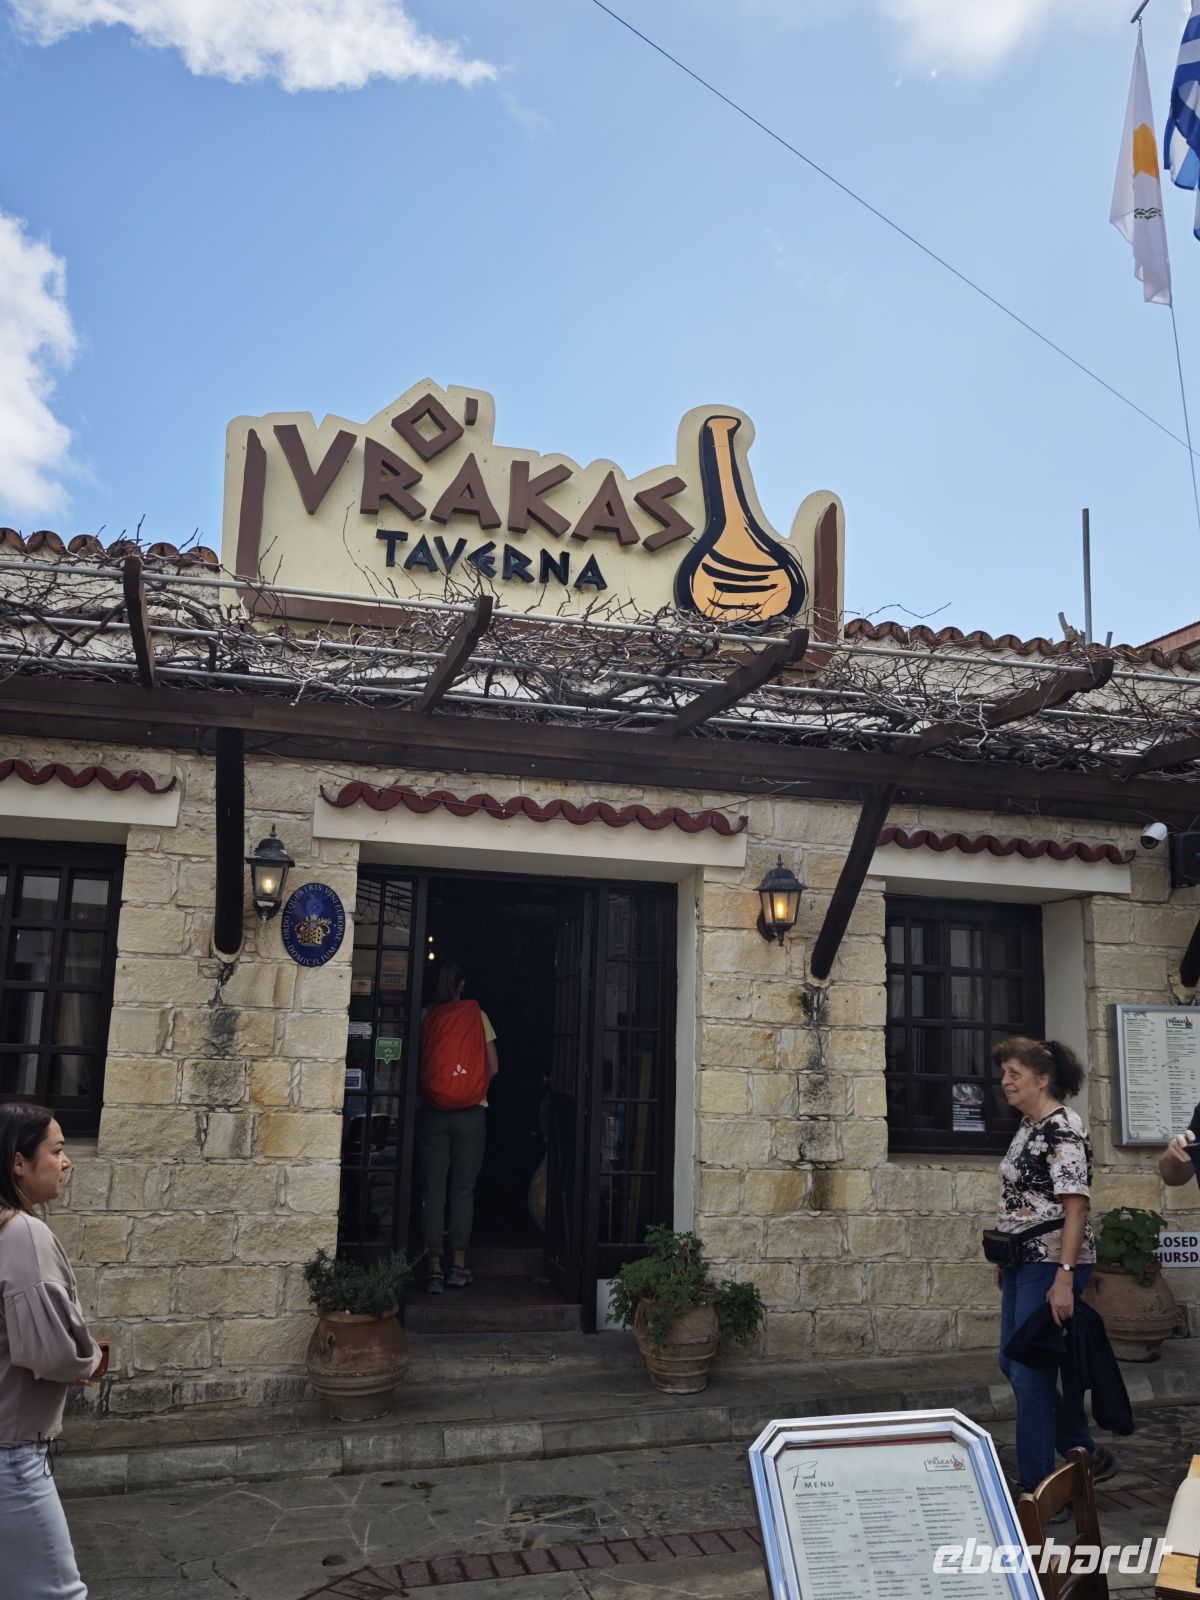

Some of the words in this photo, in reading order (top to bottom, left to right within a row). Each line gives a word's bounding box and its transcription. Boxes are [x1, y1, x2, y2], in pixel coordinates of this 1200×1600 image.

[391, 393, 479, 463] O'
[273, 424, 695, 552] VRAKAS
[375, 529, 608, 591] TAVERNA
[1155, 1251, 1200, 1263] HURSD
[804, 1480, 835, 1489] MENU
